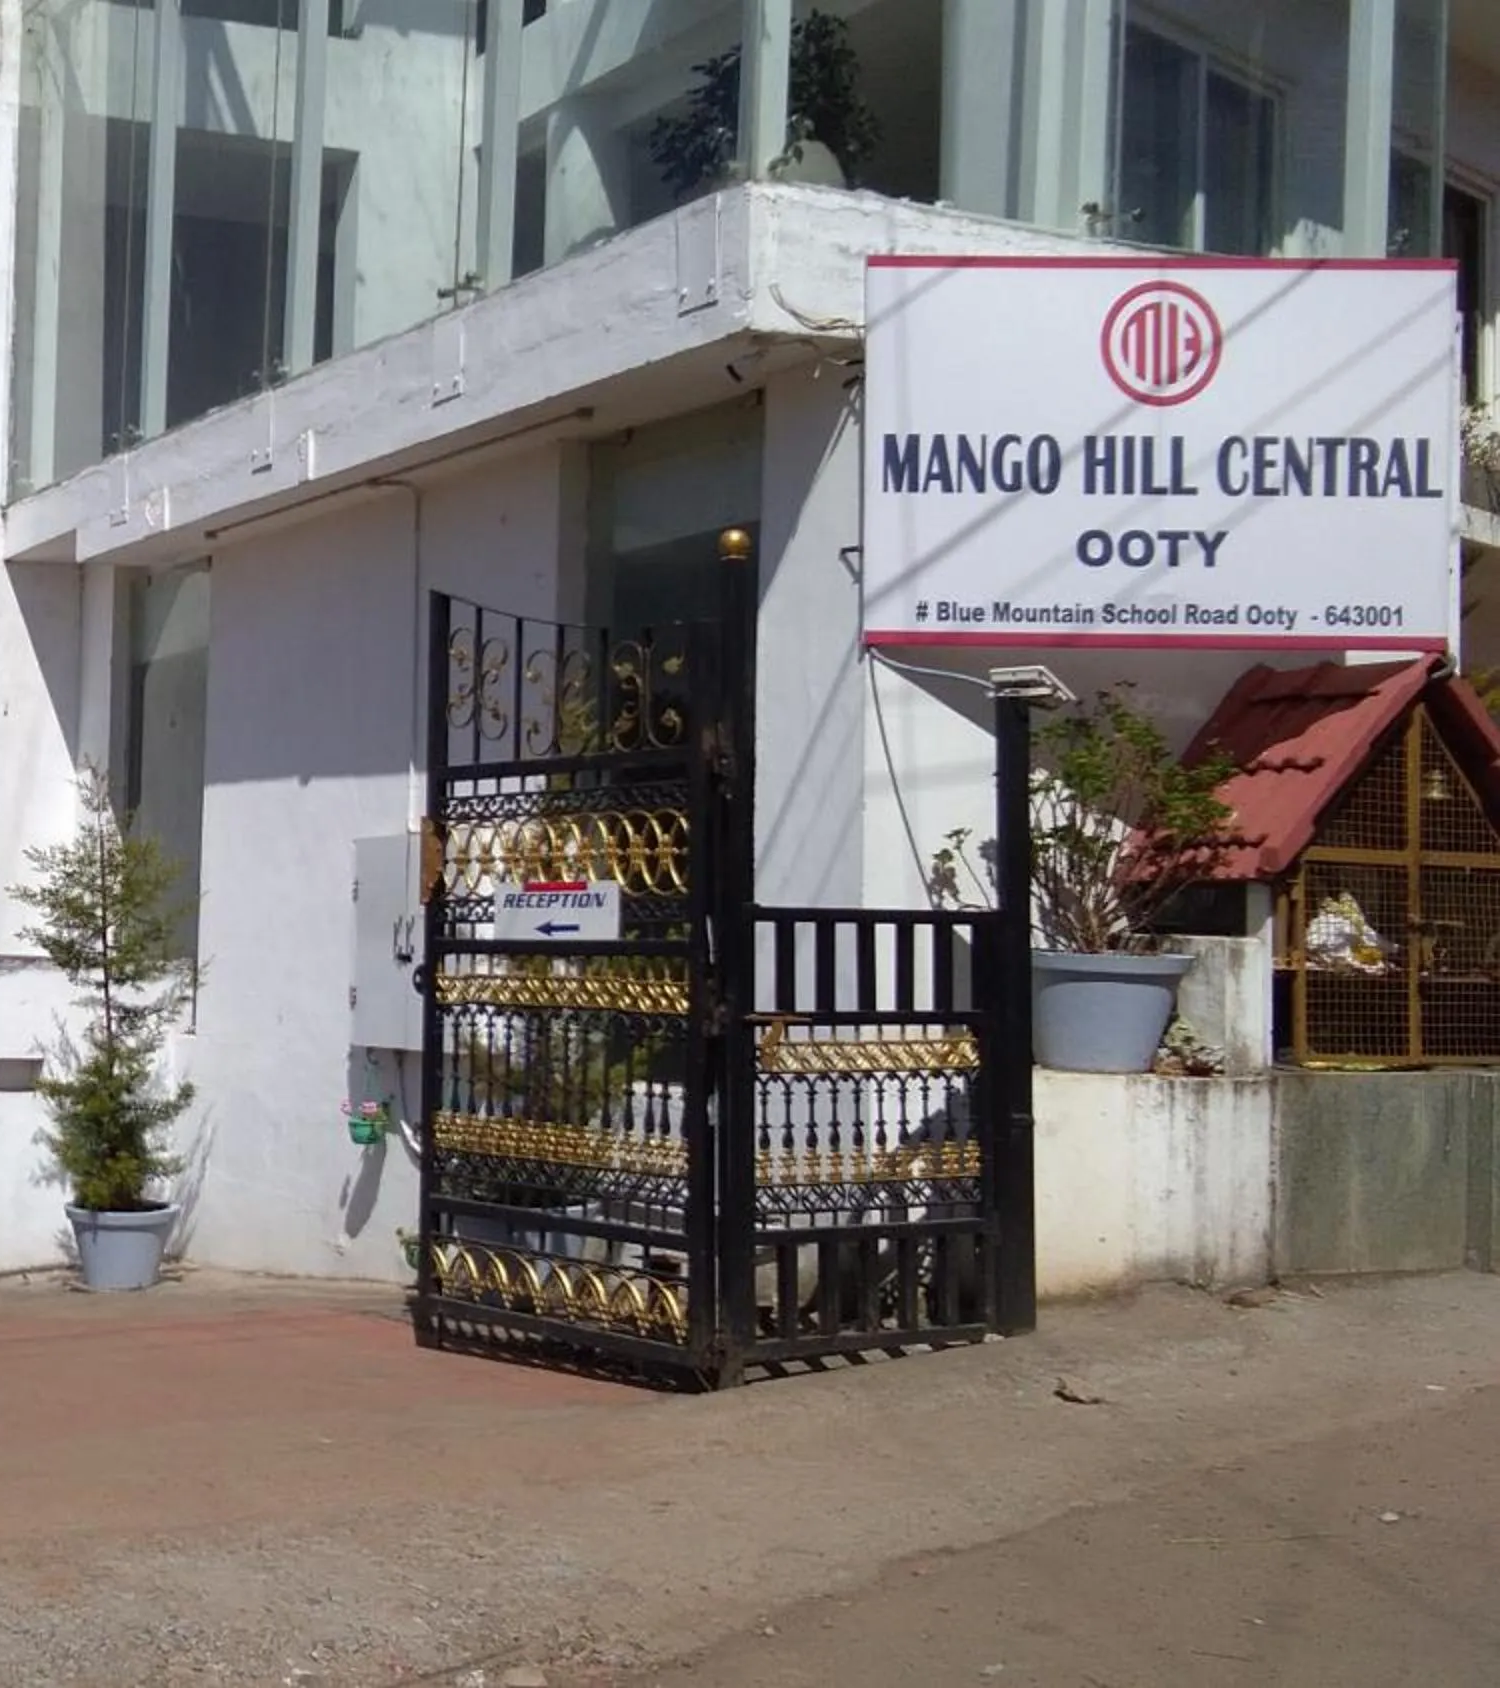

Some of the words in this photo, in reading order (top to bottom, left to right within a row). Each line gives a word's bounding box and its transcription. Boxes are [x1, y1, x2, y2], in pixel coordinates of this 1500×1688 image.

[882, 433, 1061, 494] MANGO
[1083, 435, 1198, 496] HILL
[1217, 436, 1443, 499] CENTRAL
[1076, 529, 1229, 568] OOTY
[916, 601, 929, 622] #
[936, 600, 985, 622] Blue
[992, 601, 1094, 624] Mountain
[1101, 602, 1177, 624] School
[1184, 603, 1239, 625] Road
[1246, 604, 1298, 631] Ooty
[1325, 605, 1404, 626] 643001
[503, 893, 607, 909] RECEPTION
